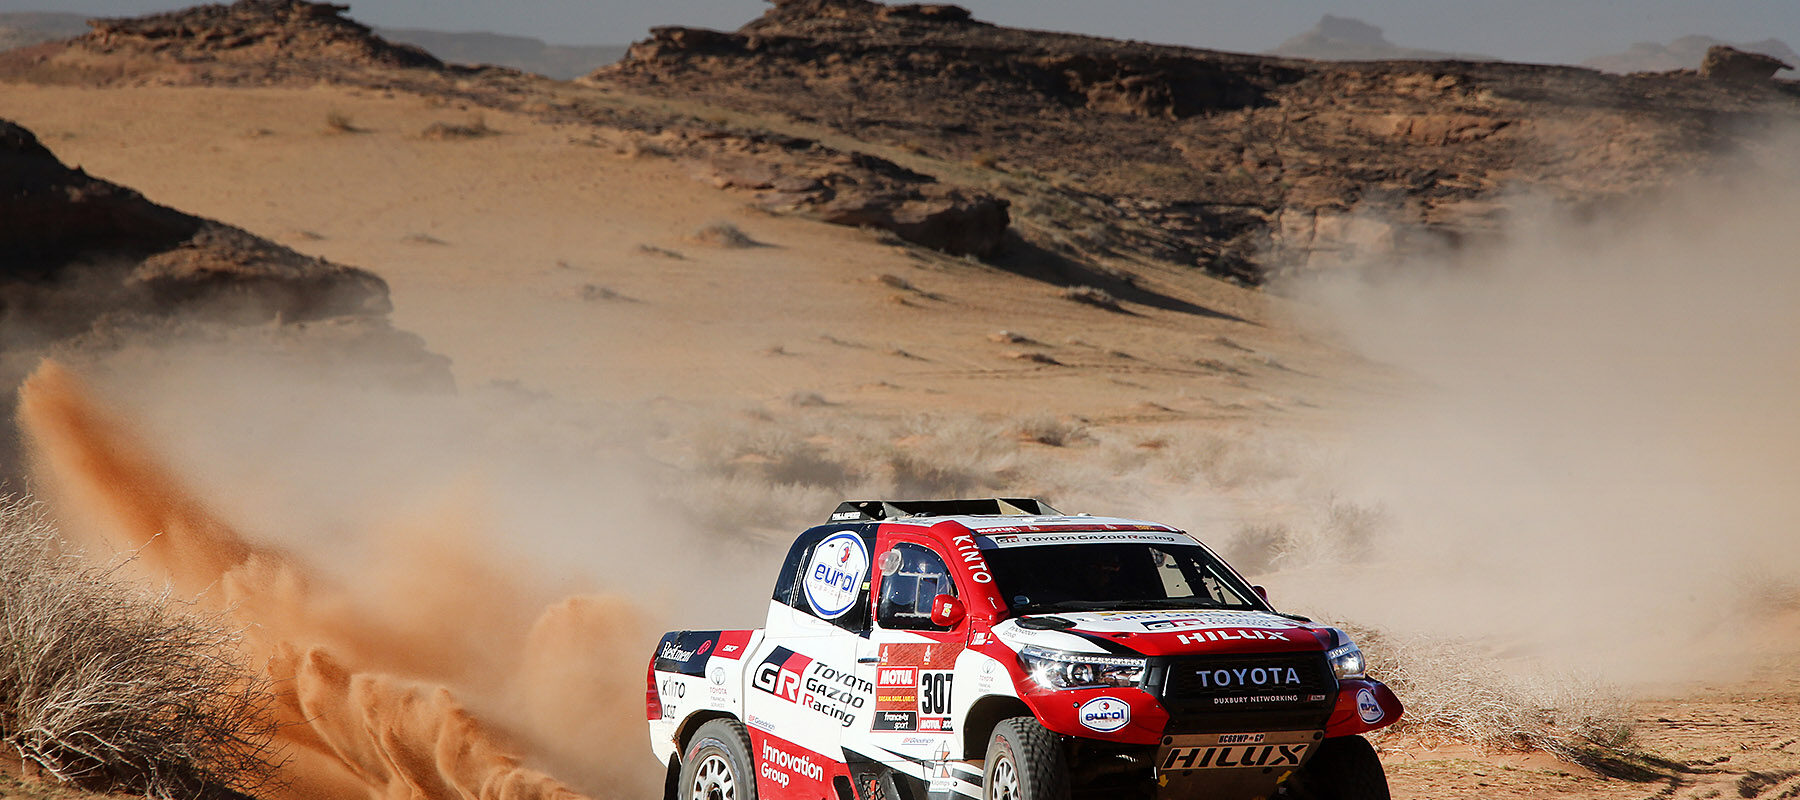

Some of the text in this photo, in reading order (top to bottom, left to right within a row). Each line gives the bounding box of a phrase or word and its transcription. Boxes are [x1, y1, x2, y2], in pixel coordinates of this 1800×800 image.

[1127, 534, 1175, 542] Racing
[814, 563, 859, 593] eurol
[1176, 630, 1291, 645] HILUX
[753, 662, 801, 704] GR
[813, 661, 873, 695] TOYOTA
[879, 669, 914, 685] MOTUL
[1195, 667, 1301, 688] TOYOTA
[806, 677, 865, 709] GAZOO
[921, 673, 954, 714] 307
[1213, 696, 1248, 704] DUXBURY
[1250, 694, 1298, 703] NETWORKING
[802, 693, 856, 728] Racing
[1085, 709, 1125, 721] eurol
[893, 721, 909, 731] sport
[920, 720, 941, 730] MOTUL
[1162, 743, 1308, 769] HILUX
[760, 762, 790, 789] Group
